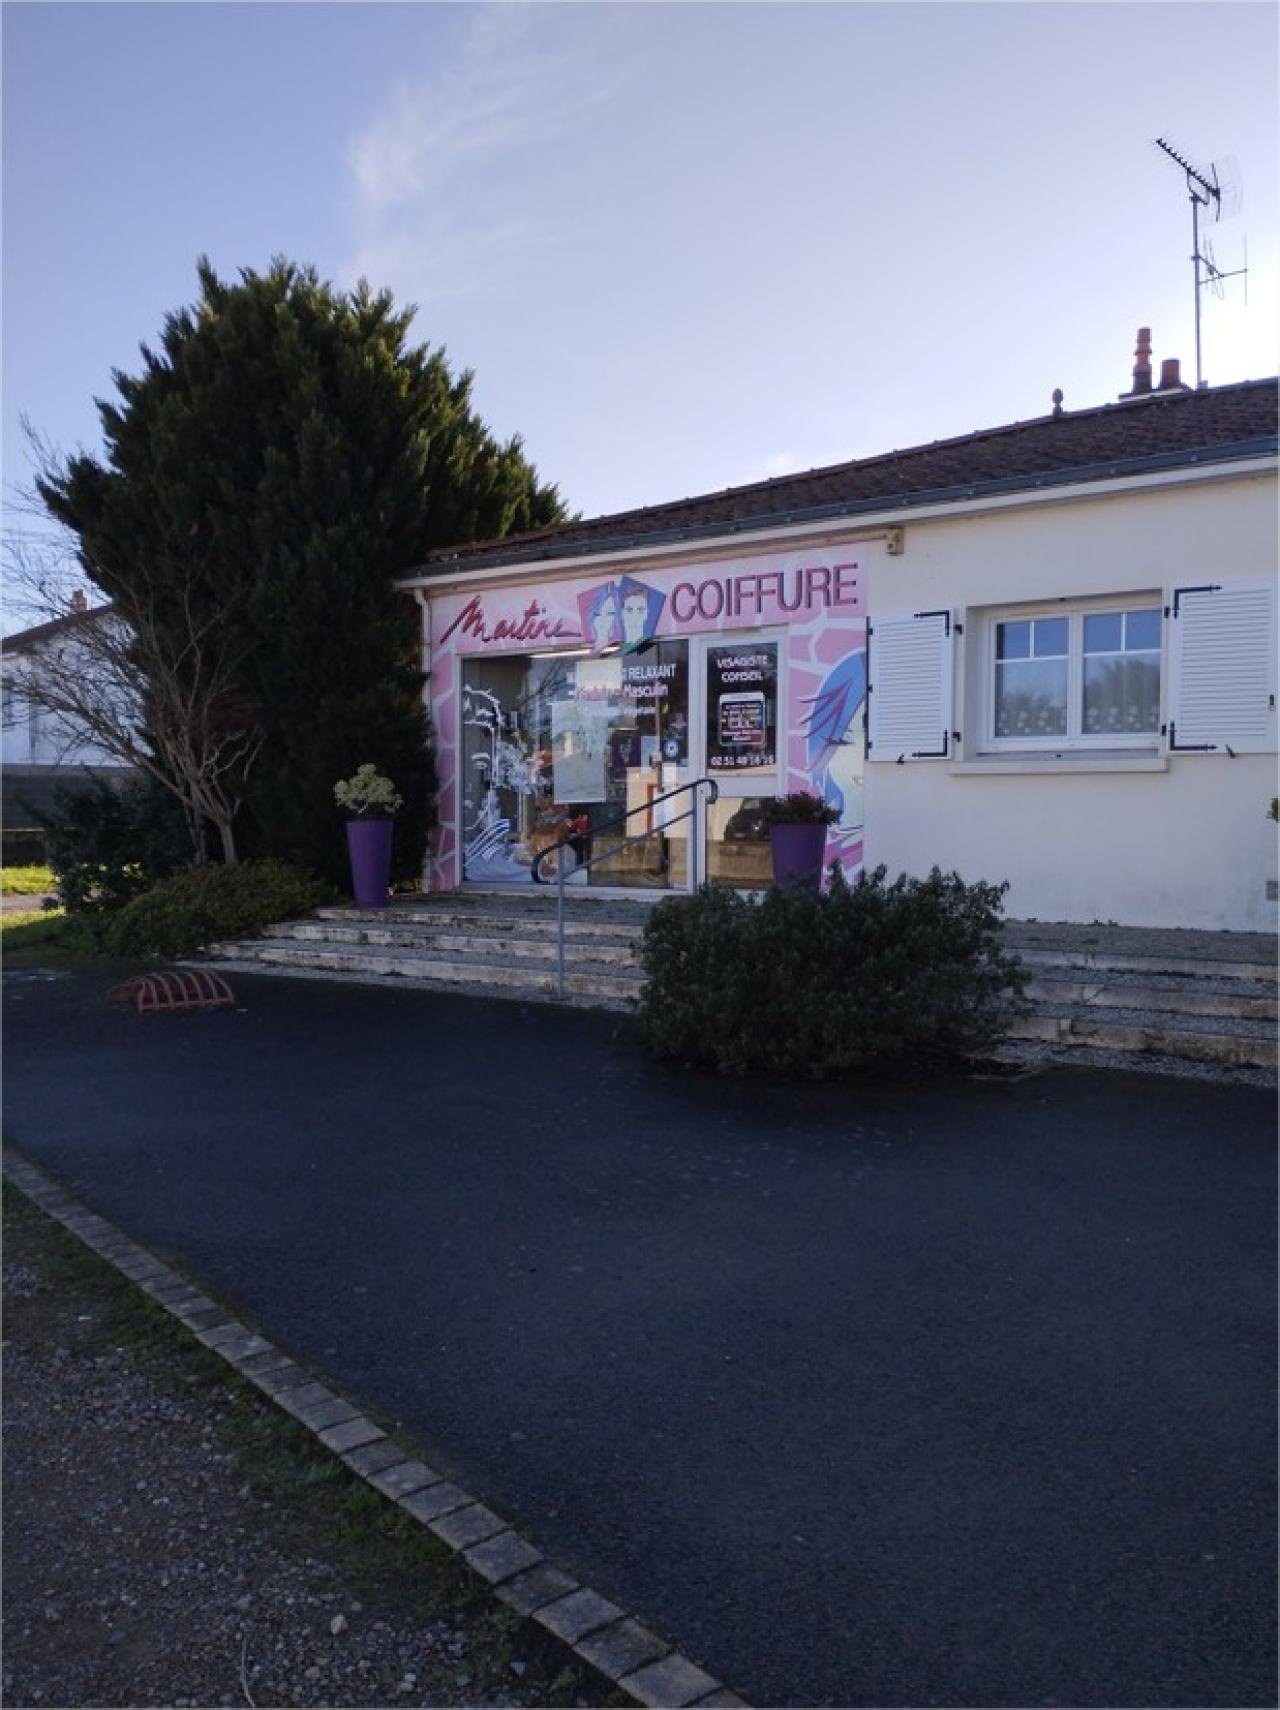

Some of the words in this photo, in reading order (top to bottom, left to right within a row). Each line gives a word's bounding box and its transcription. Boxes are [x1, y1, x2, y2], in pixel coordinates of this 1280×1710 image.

[671, 563, 859, 622] COIFFURE
[440, 595, 582, 645] Martine
[628, 663, 676, 682] RELAXANT
[721, 670, 764, 683] CONSEIL
